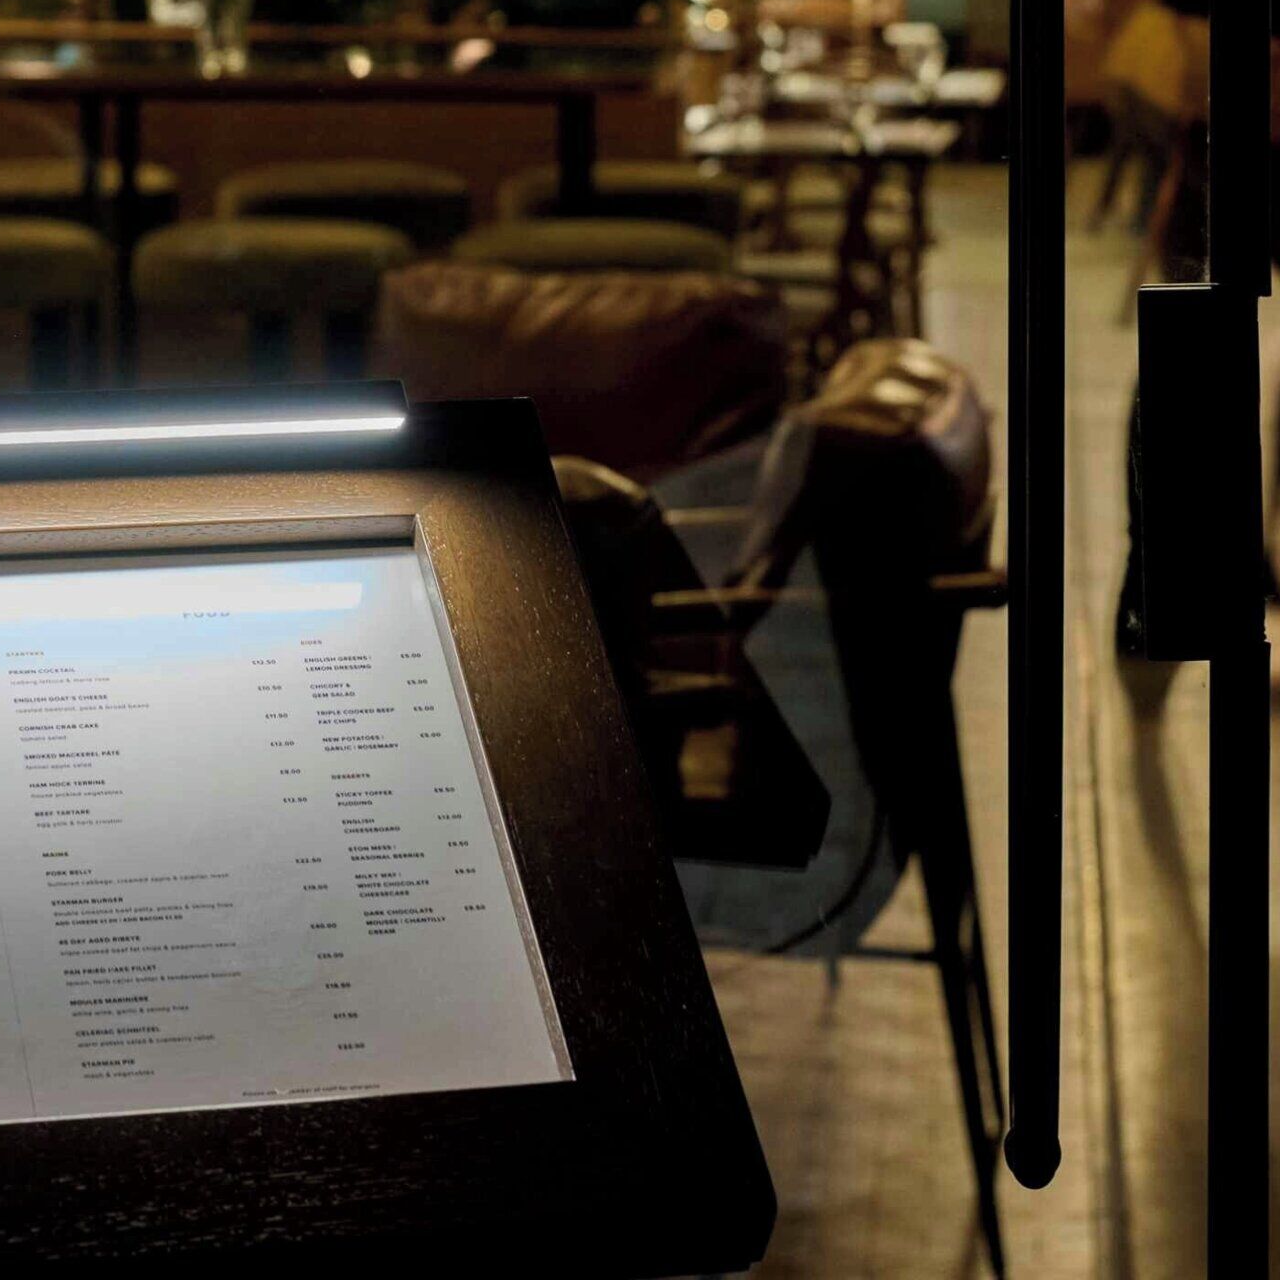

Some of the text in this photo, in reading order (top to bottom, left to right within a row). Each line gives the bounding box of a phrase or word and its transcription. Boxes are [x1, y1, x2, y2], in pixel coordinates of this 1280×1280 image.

[304, 654, 367, 664] ENGLISH GREENS
[334, 663, 372, 671] DRESSING
[8, 668, 37, 676] PRAWN
[310, 682, 344, 690] CHICORY
[13, 696, 47, 704] ENGLISH
[78, 693, 108, 701] CHEESE
[343, 707, 374, 715] COOKED
[376, 706, 395, 714] BEEF
[18, 724, 54, 732] CORNISH
[341, 734, 379, 742] POTATOES
[357, 742, 399, 750] ROSEMARY
[23, 752, 57, 760] SMOKED
[58, 751, 99, 759] MACKEREL
[331, 772, 371, 780] DESSERTS
[49, 780, 71, 788] HOCK
[364, 789, 393, 797] TOFFEE
[337, 799, 373, 807] PUDDING
[341, 817, 375, 825] ENGLISH
[344, 825, 401, 834] CHEESEBOARD
[351, 851, 425, 861] SEASONAL BERRIES
[45, 868, 92, 877] PORK BELLY
[355, 871, 397, 880] MILKY WAY
[357, 879, 430, 889] WHITE CHOCOLATE
[359, 889, 410, 898] CHEESECAKE
[51, 896, 124, 906] STARMAN BURGER
[363, 907, 434, 917] DARK CHOCOLATE
[366, 916, 447, 926] MOUSSE CHANTILLY
[75, 1026, 160, 1037] CELERIAC SCHNITZEL
[81, 1059, 120, 1068] STARMAN
